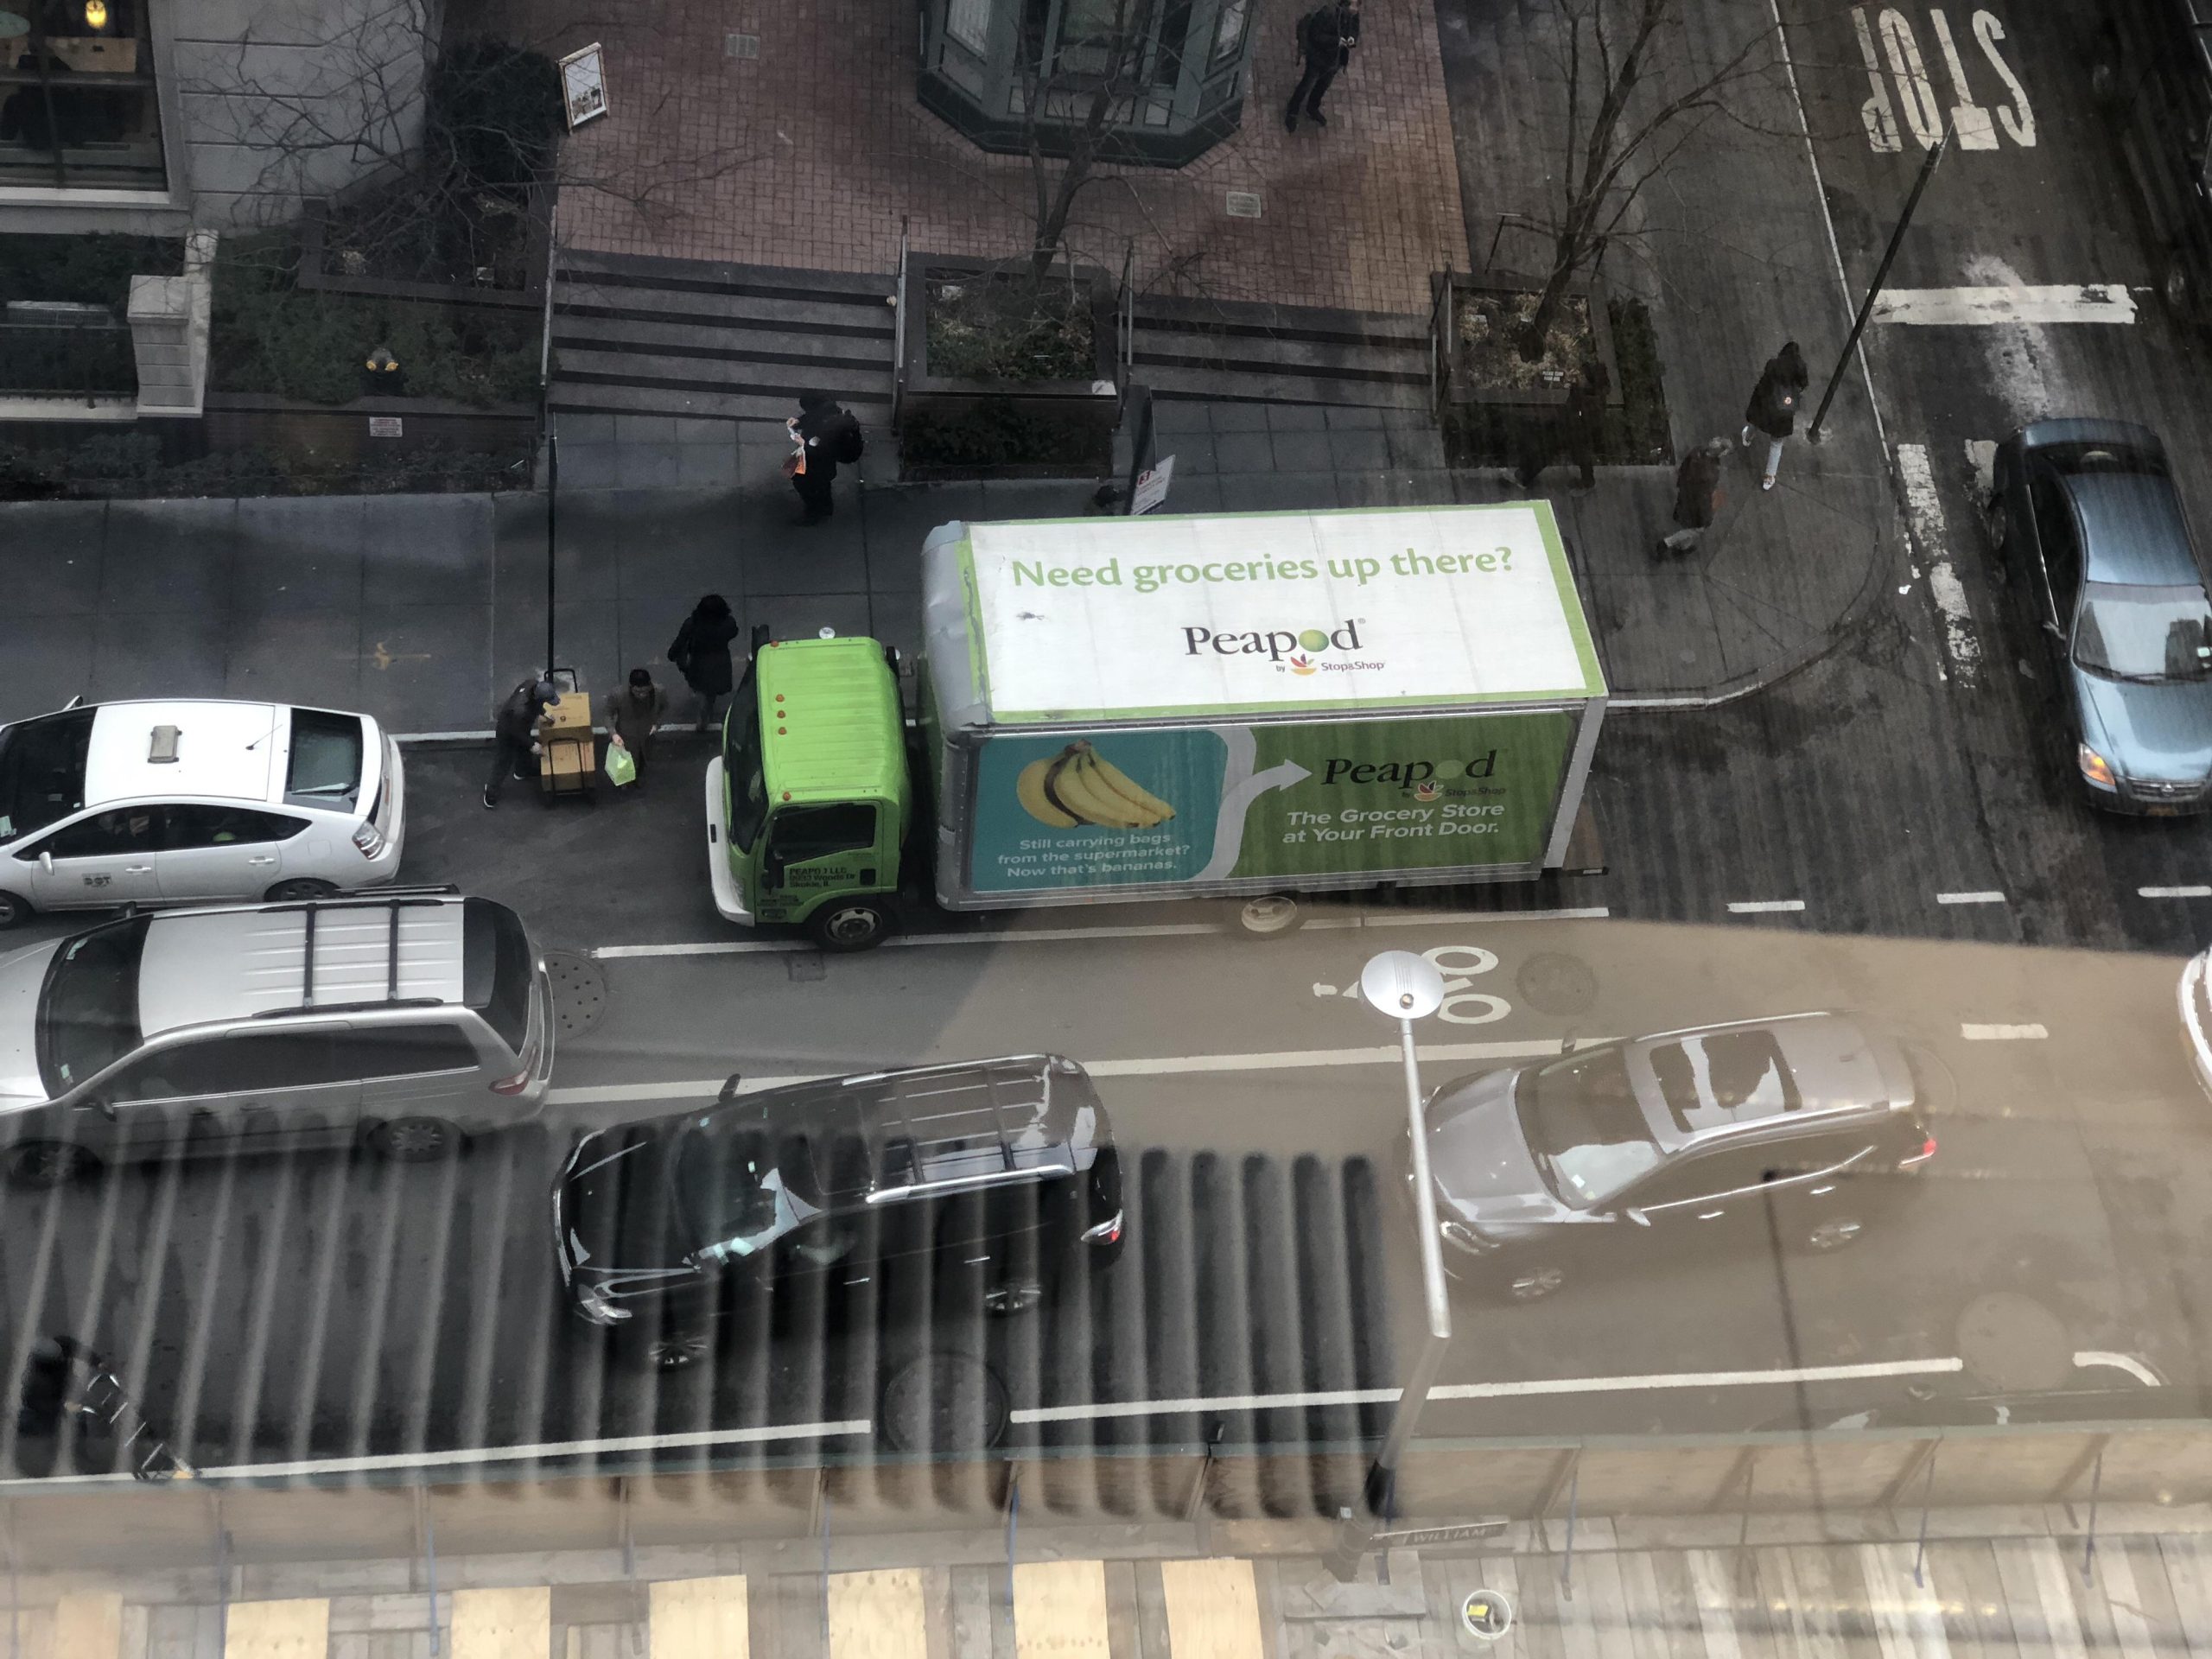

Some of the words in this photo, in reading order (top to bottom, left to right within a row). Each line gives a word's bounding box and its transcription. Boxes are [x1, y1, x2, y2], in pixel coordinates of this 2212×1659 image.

[1851, 6, 2037, 152] STOP
[1012, 557, 1122, 587] Need
[1133, 553, 1319, 594] groceries
[1327, 557, 1381, 586] up
[1389, 546, 1512, 576] there?
[1181, 619, 1363, 662] Peapod
[1276, 664, 1286, 673] by
[1320, 749, 1497, 790] Peapod
[1287, 810, 1332, 826] The
[1339, 806, 1434, 823] Grocery
[1440, 804, 1505, 818] Store
[1020, 839, 1051, 850] Still
[1056, 835, 1124, 849] carrying
[1129, 833, 1171, 845] bags
[1282, 830, 1306, 843] at
[1313, 828, 1365, 842] Your
[1370, 823, 1433, 839] Front
[1438, 821, 1499, 836] Door.
[998, 855, 1037, 865] from
[1042, 851, 1070, 862] the
[1073, 844, 1190, 861] supermarket?
[1007, 867, 1046, 878] Now
[1050, 863, 1096, 875] that's
[1102, 860, 1177, 873] bananas.
